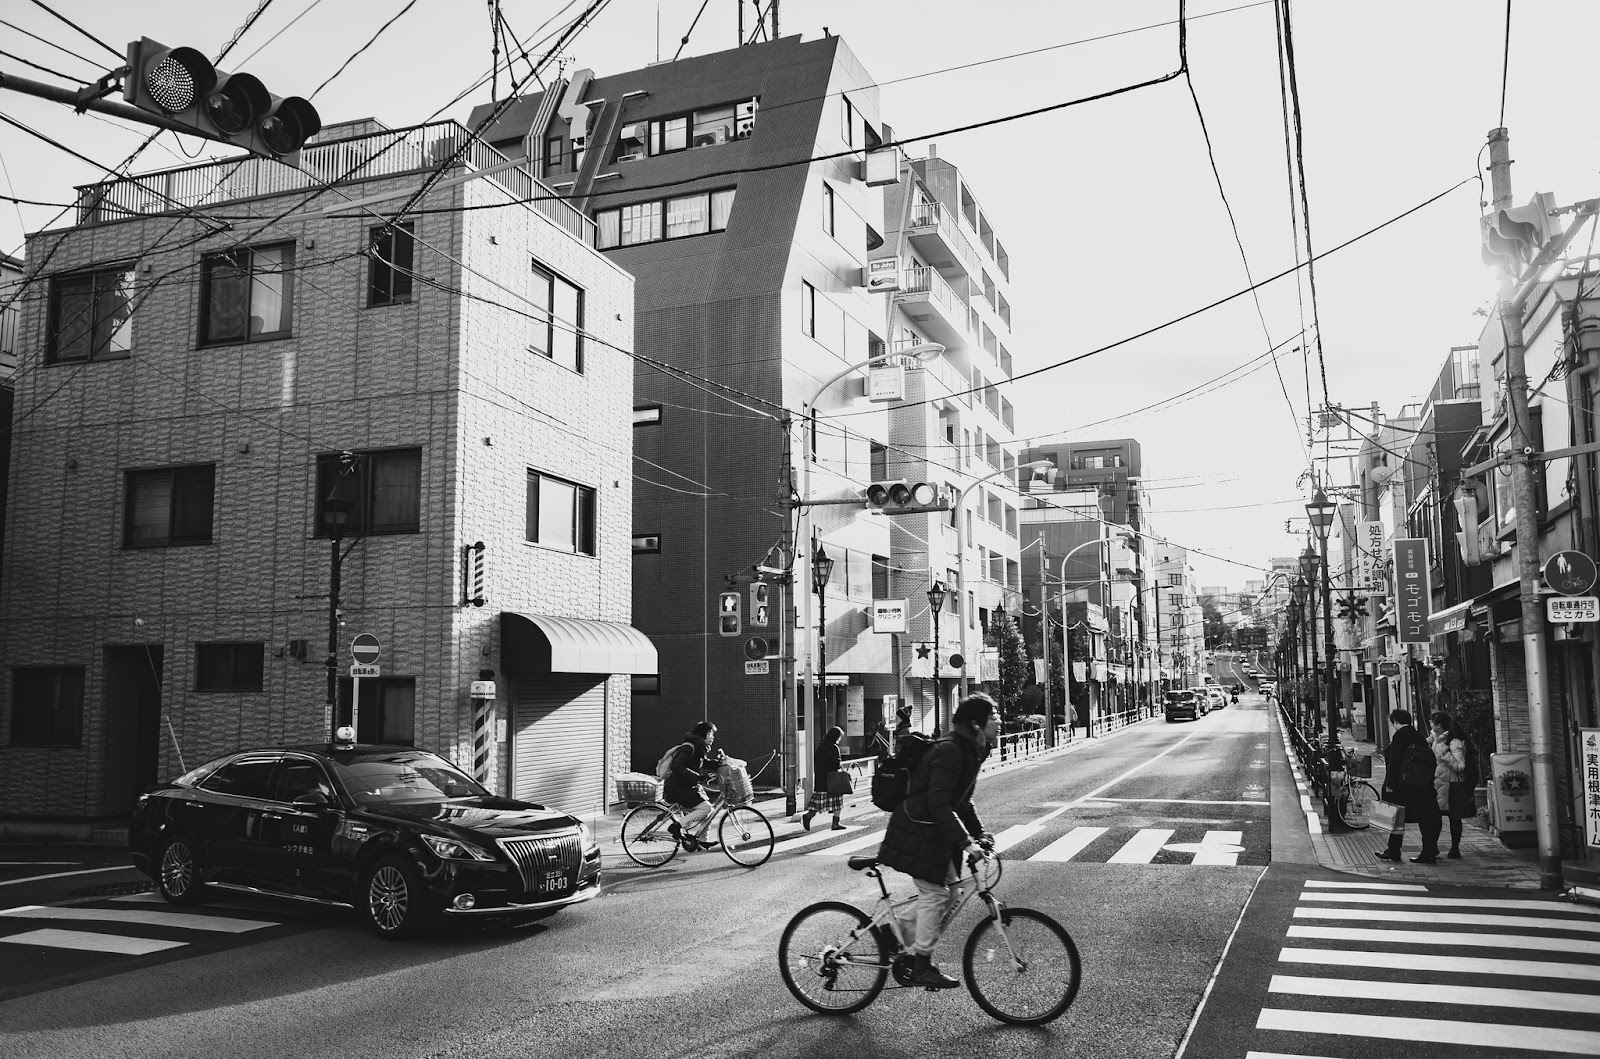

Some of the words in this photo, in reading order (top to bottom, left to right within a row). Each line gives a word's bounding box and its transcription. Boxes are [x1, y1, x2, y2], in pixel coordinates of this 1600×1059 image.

[1369, 525, 1385, 592] 処方せん調剤
[1405, 583, 1424, 635] モゴモゴ
[1551, 600, 1595, 610] 自転車通行可
[1552, 610, 1595, 619] ここから
[352, 667, 378, 675] 自転車を除く
[545, 877, 568, 892] 10-03
